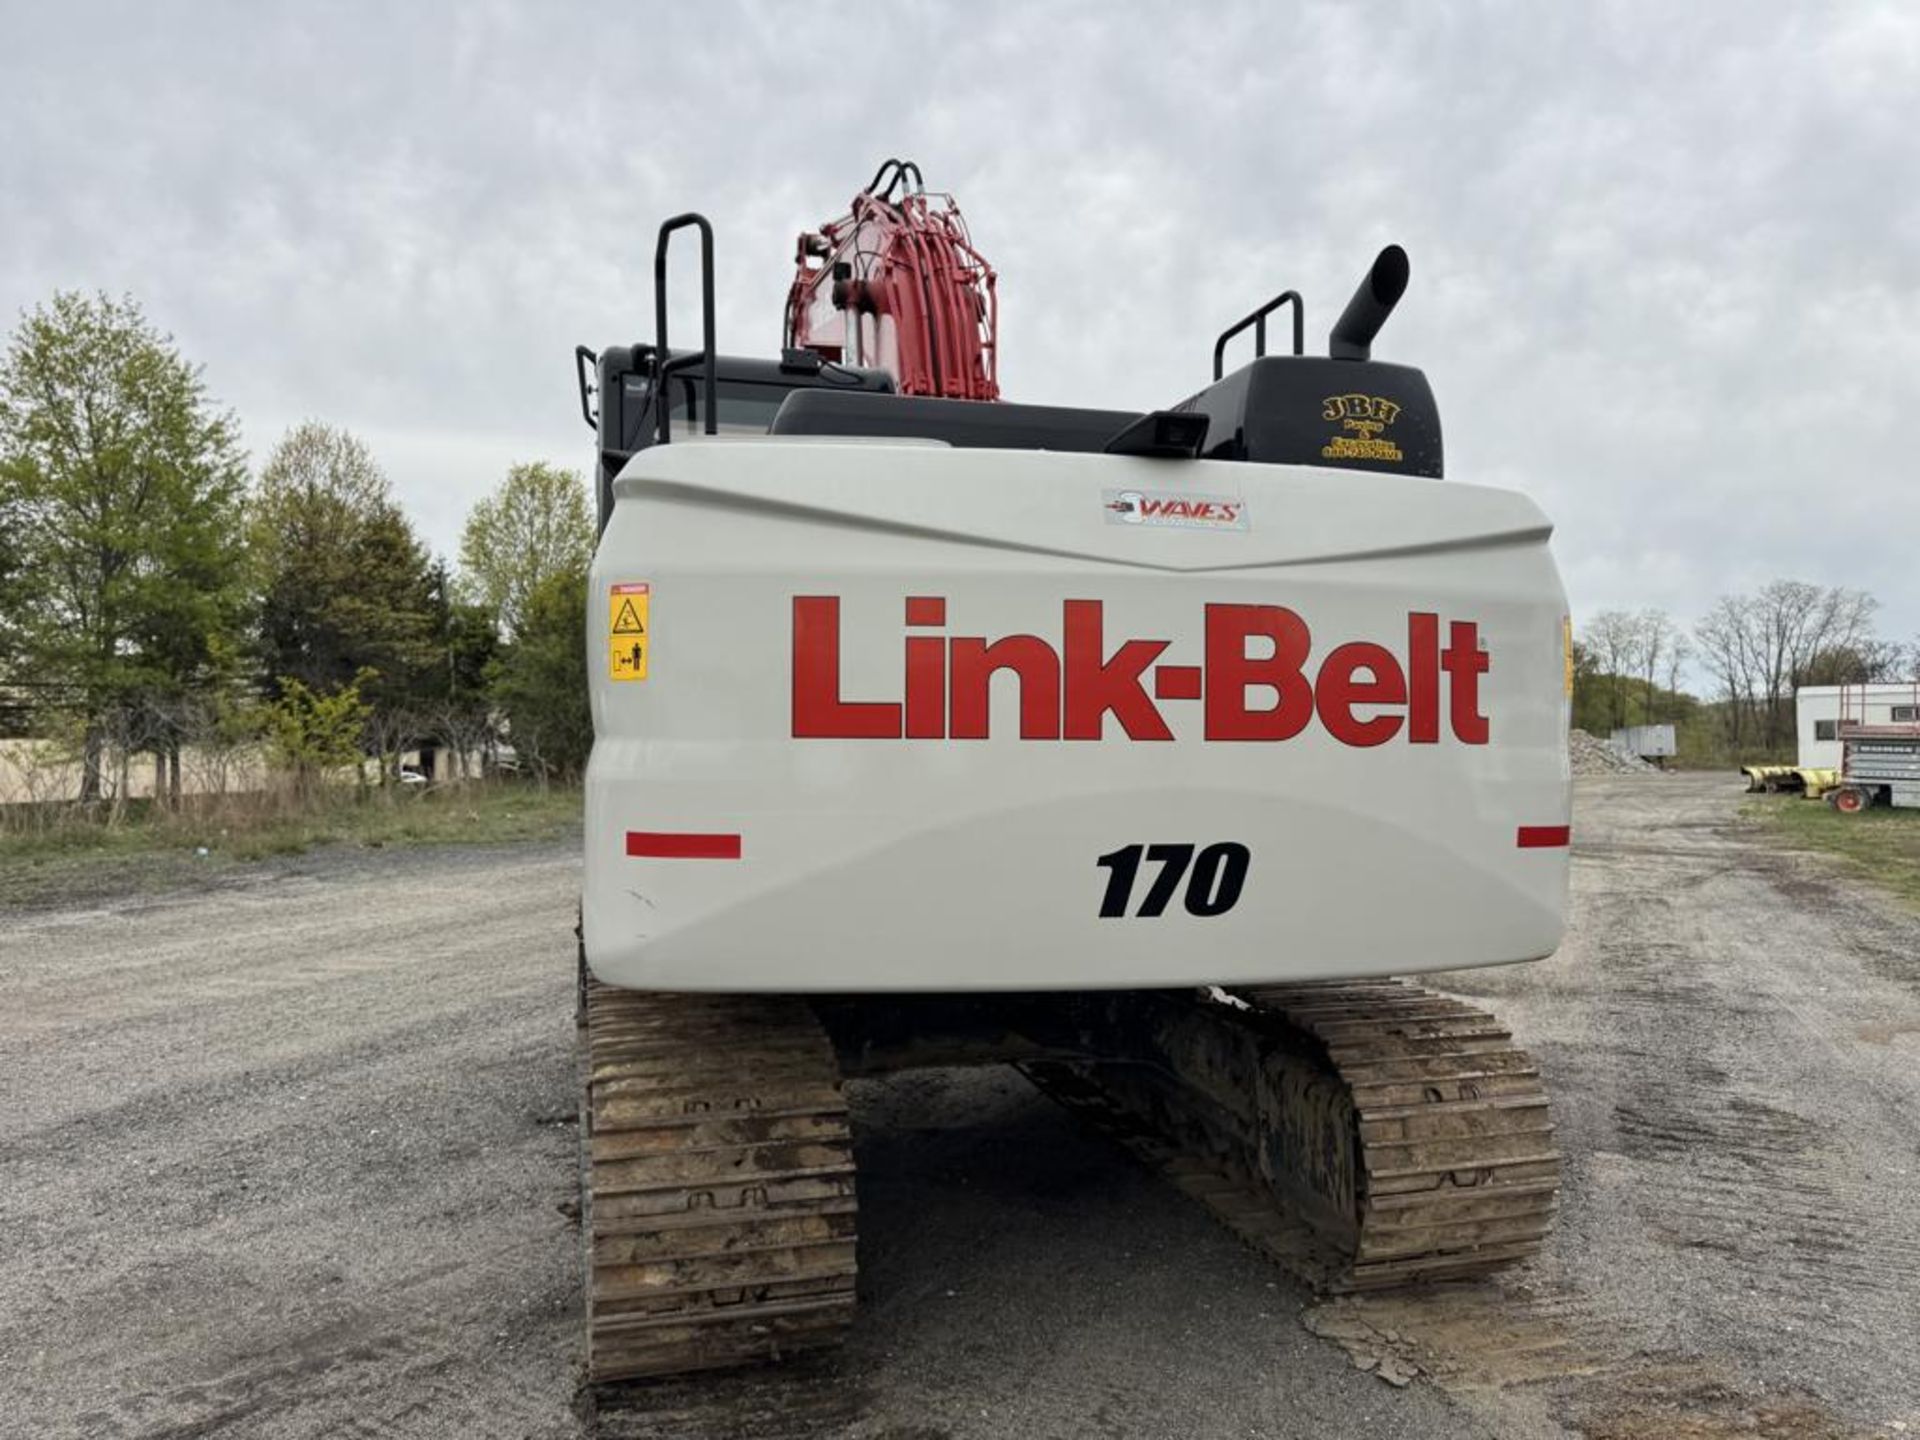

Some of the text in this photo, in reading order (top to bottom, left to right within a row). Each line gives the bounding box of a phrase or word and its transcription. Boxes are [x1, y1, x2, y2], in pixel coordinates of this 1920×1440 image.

[1322, 394, 1401, 424] JBH
[1138, 498, 1240, 522] WAVES
[792, 596, 1489, 747] Link-Belt
[1097, 842, 1251, 918] 170
